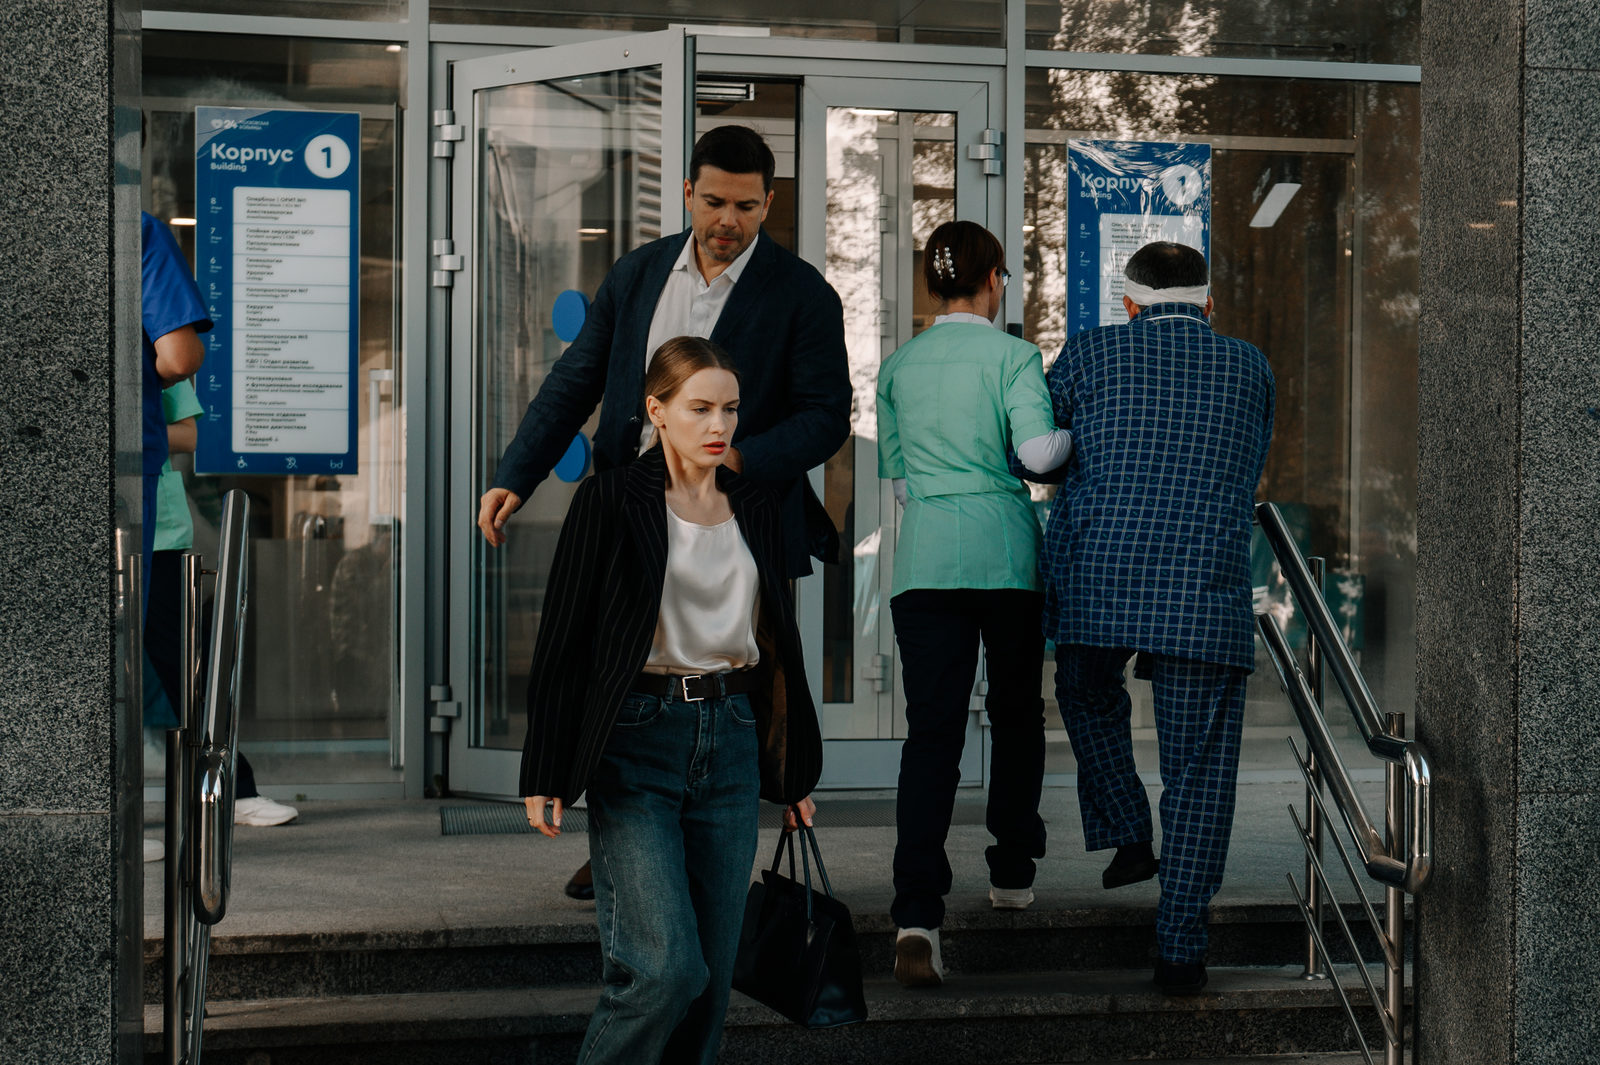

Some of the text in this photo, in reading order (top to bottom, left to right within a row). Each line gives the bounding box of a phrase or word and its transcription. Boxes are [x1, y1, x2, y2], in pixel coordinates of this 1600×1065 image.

[211, 143, 331, 168] Корпус 1
[210, 163, 247, 172] Building
[1081, 173, 1152, 193] Корпу
[1080, 191, 1112, 200] Buding
